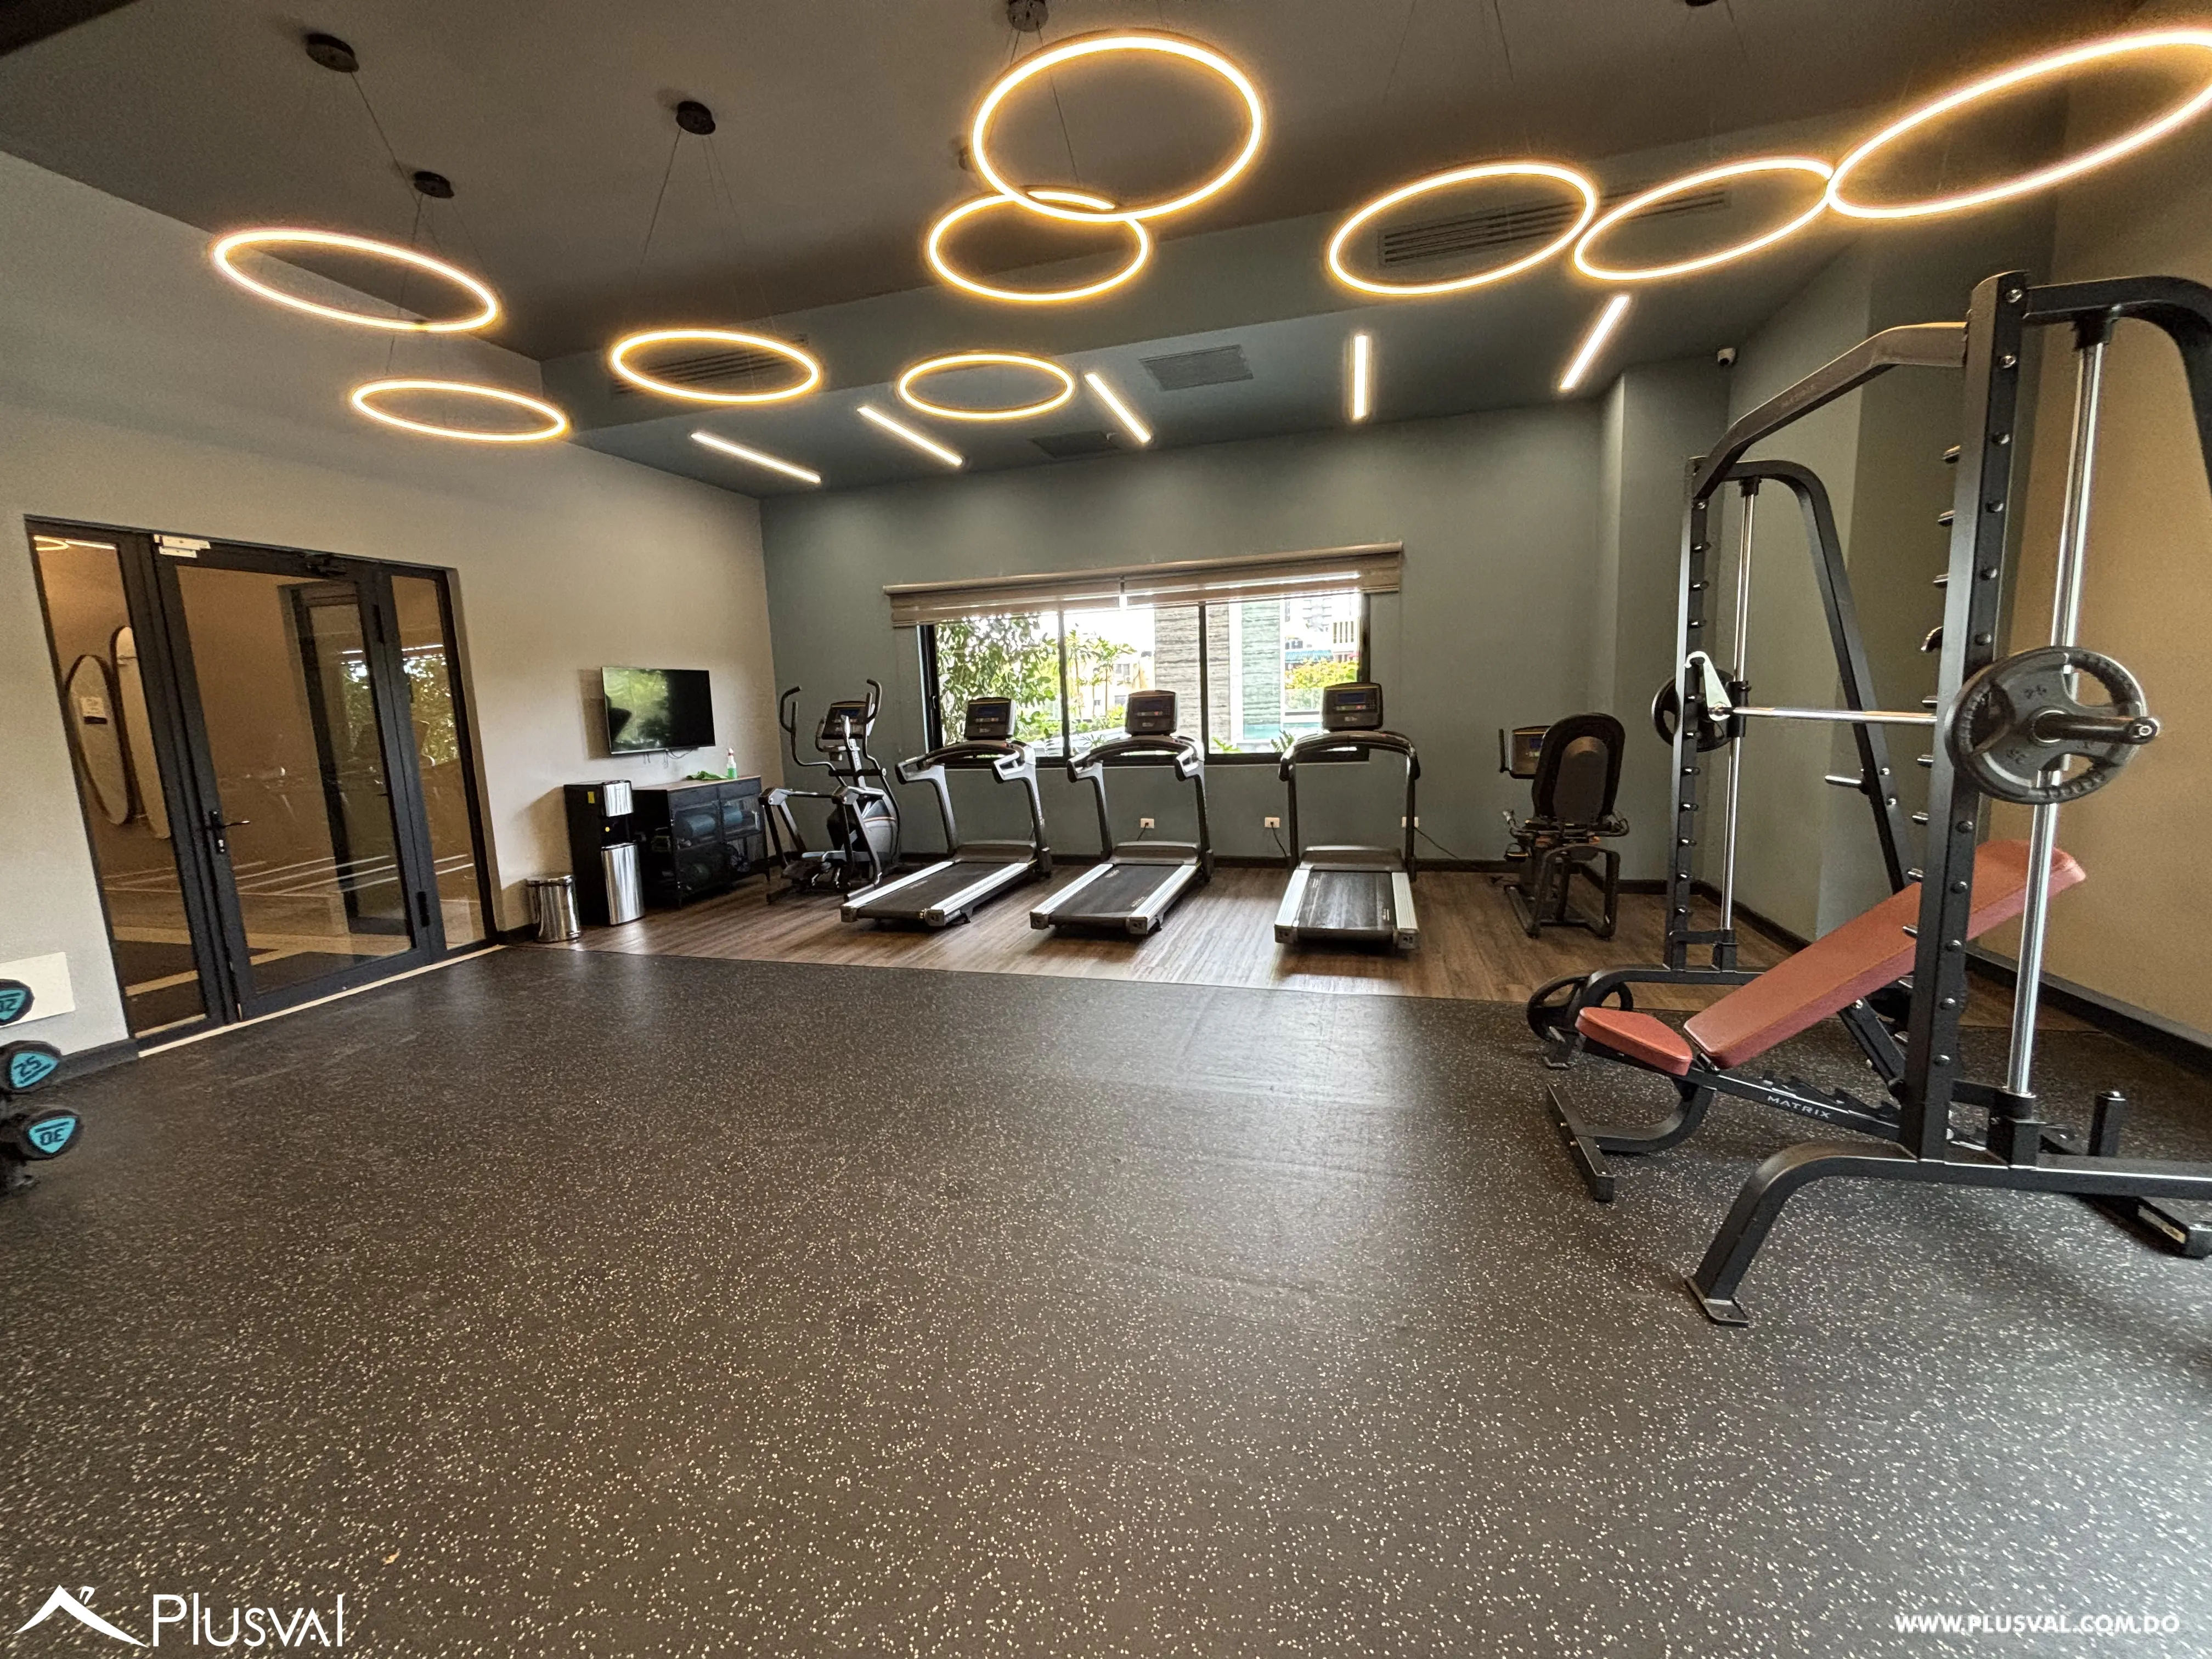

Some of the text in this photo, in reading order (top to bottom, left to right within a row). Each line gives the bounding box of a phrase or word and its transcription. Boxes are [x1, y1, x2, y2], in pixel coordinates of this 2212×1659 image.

[13, 1056, 42, 1077] 25
[1767, 1095, 1831, 1119] MATRIX
[40, 1127, 65, 1146] 30
